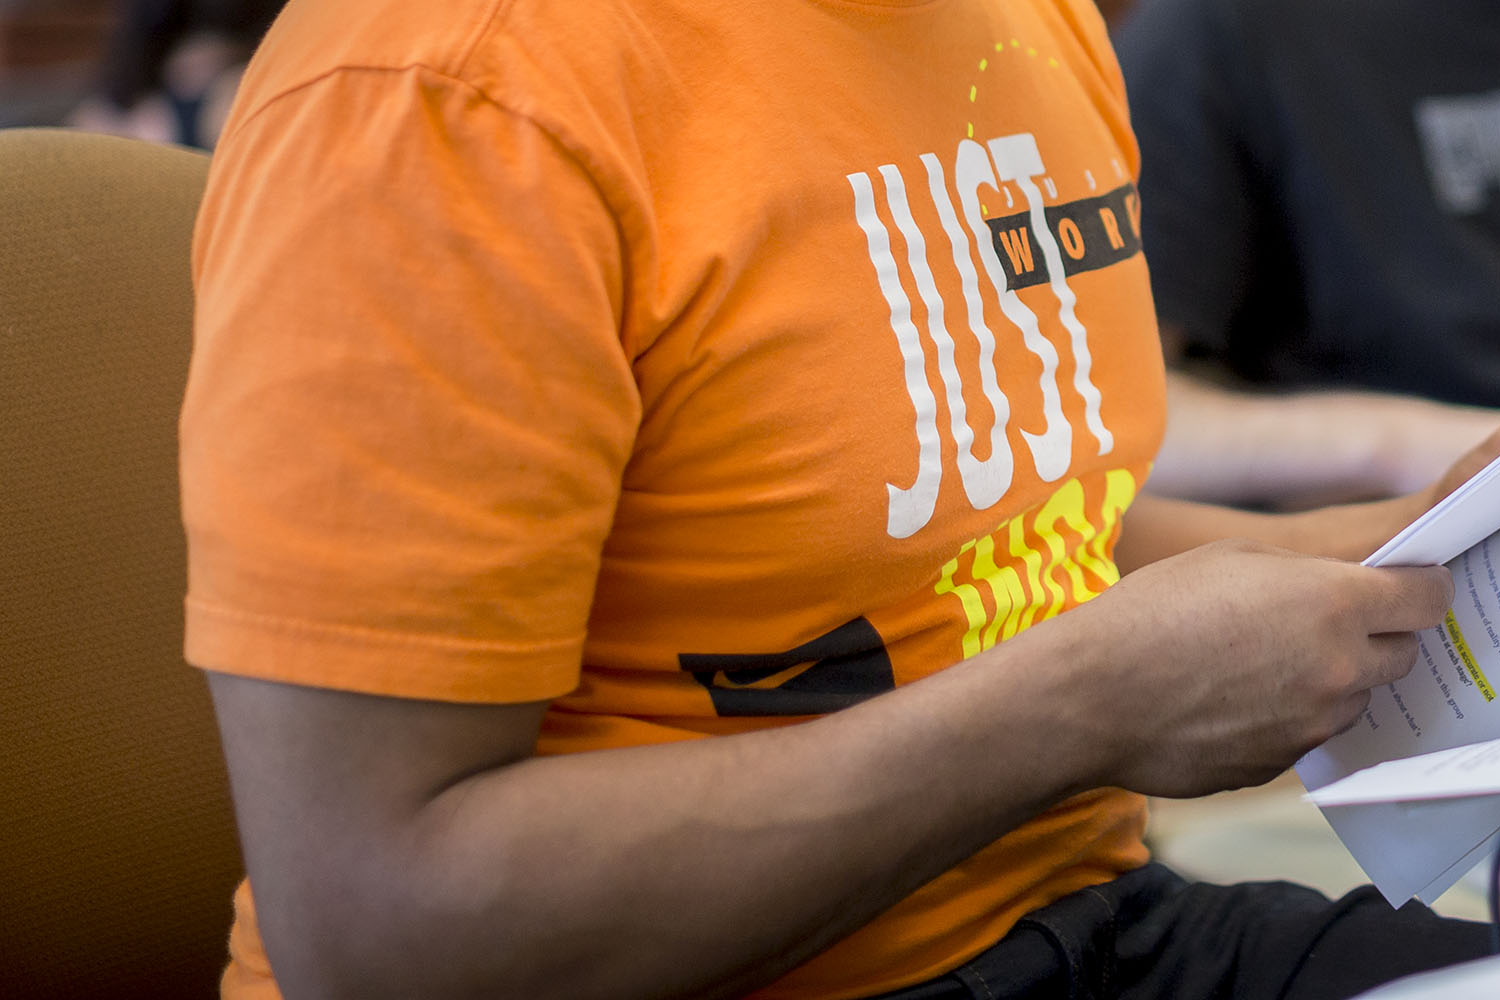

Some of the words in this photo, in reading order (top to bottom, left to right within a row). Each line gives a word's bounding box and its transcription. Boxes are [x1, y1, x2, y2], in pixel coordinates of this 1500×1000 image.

[847, 133, 1114, 540] JUST
[1485, 625, 1500, 648] reality
[1446, 648, 1460, 666] each
[1454, 664, 1473, 687] stage?
[1460, 650, 1480, 680] accurate
[1476, 679, 1486, 689] or
[1482, 688, 1494, 703] not
[1439, 682, 1450, 698] this
[1446, 697, 1465, 720] group
[1403, 711, 1422, 737] what's
